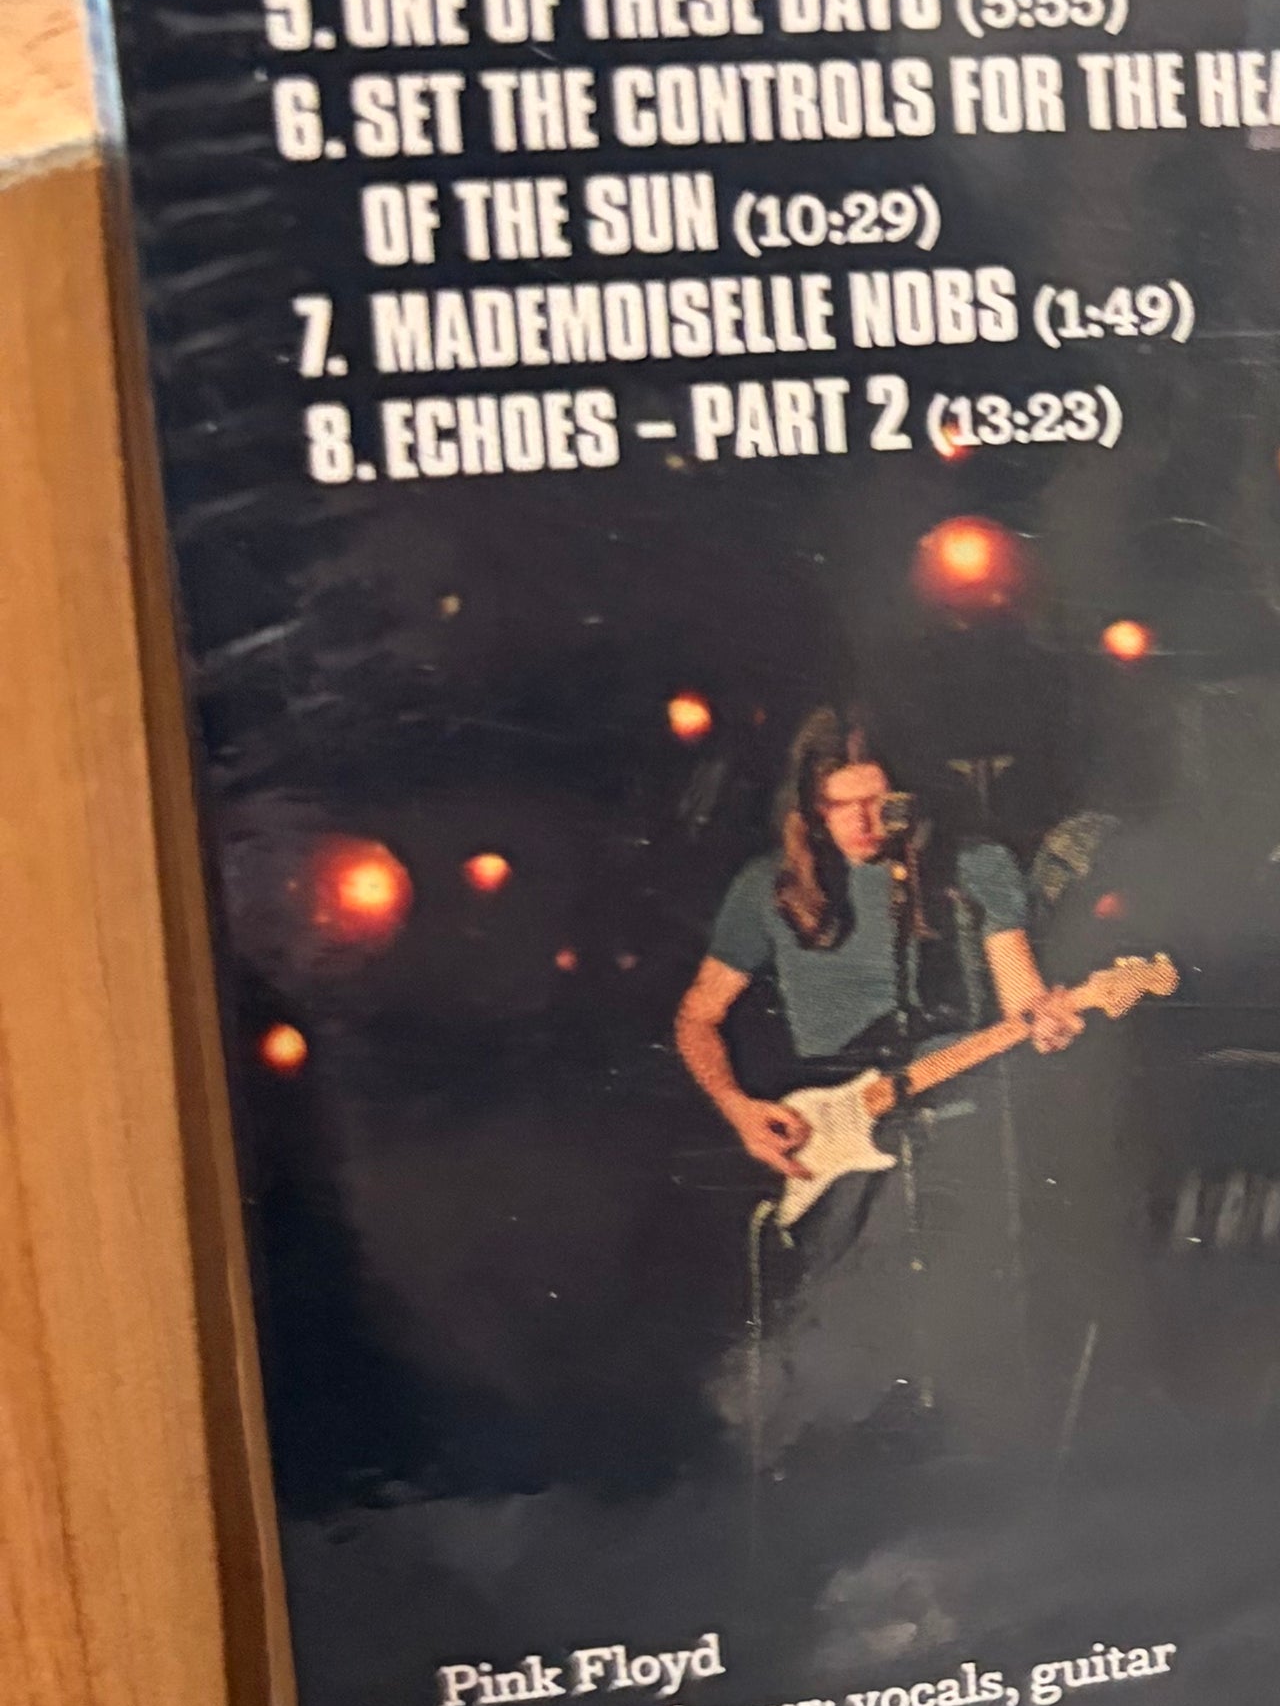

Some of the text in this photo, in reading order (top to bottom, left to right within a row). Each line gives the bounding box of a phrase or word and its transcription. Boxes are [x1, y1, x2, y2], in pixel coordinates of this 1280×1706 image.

[274, 79, 345, 159] 6.
[353, 74, 463, 156] SET
[482, 69, 598, 151] THE
[614, 59, 935, 145] CONTROLS
[951, 56, 1064, 133] FOR
[1078, 53, 1186, 130] THE
[363, 174, 940, 264] OF THE SUN (10:29)
[294, 267, 1194, 376] 7. MADEMOISELLE NOBS (1:49)
[307, 405, 376, 482] 8.
[383, 390, 618, 478] ECHOES
[692, 378, 849, 460] PART
[867, 375, 911, 450] 2
[927, 386, 1122, 457] (13:23)
[573, 1633, 725, 1695] Floyd
[1031, 1644, 1176, 1705] guitar
